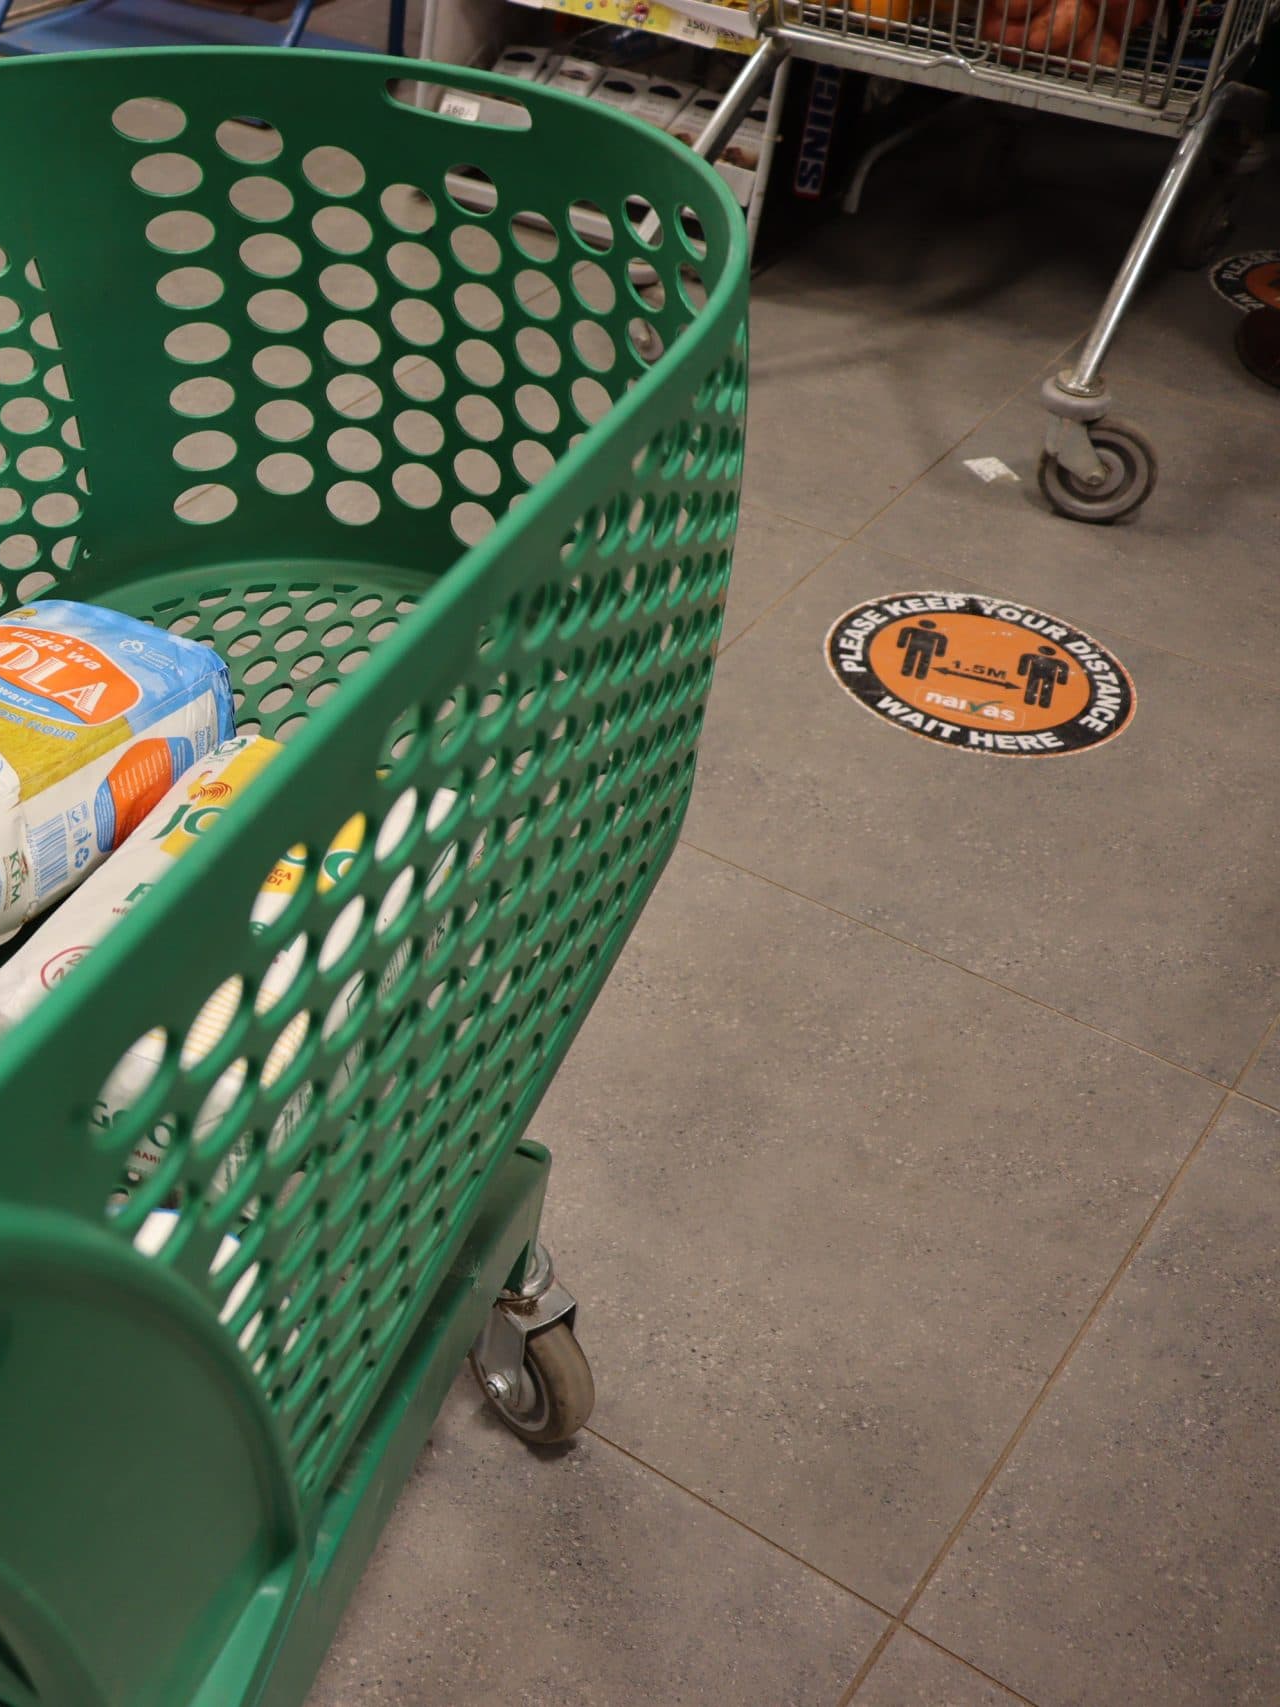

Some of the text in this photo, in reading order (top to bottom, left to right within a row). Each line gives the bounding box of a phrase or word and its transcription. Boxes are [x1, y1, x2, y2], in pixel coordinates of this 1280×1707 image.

[12, 630, 102, 671] unga wa
[839, 597, 1121, 733] PLEASE KEEP YOUR DISTANCE
[951, 659, 1008, 680] 1.5M
[27, 720, 78, 742] FLOUR
[876, 695, 1065, 750] WAIT HERE
[9, 850, 22, 905] KFM
